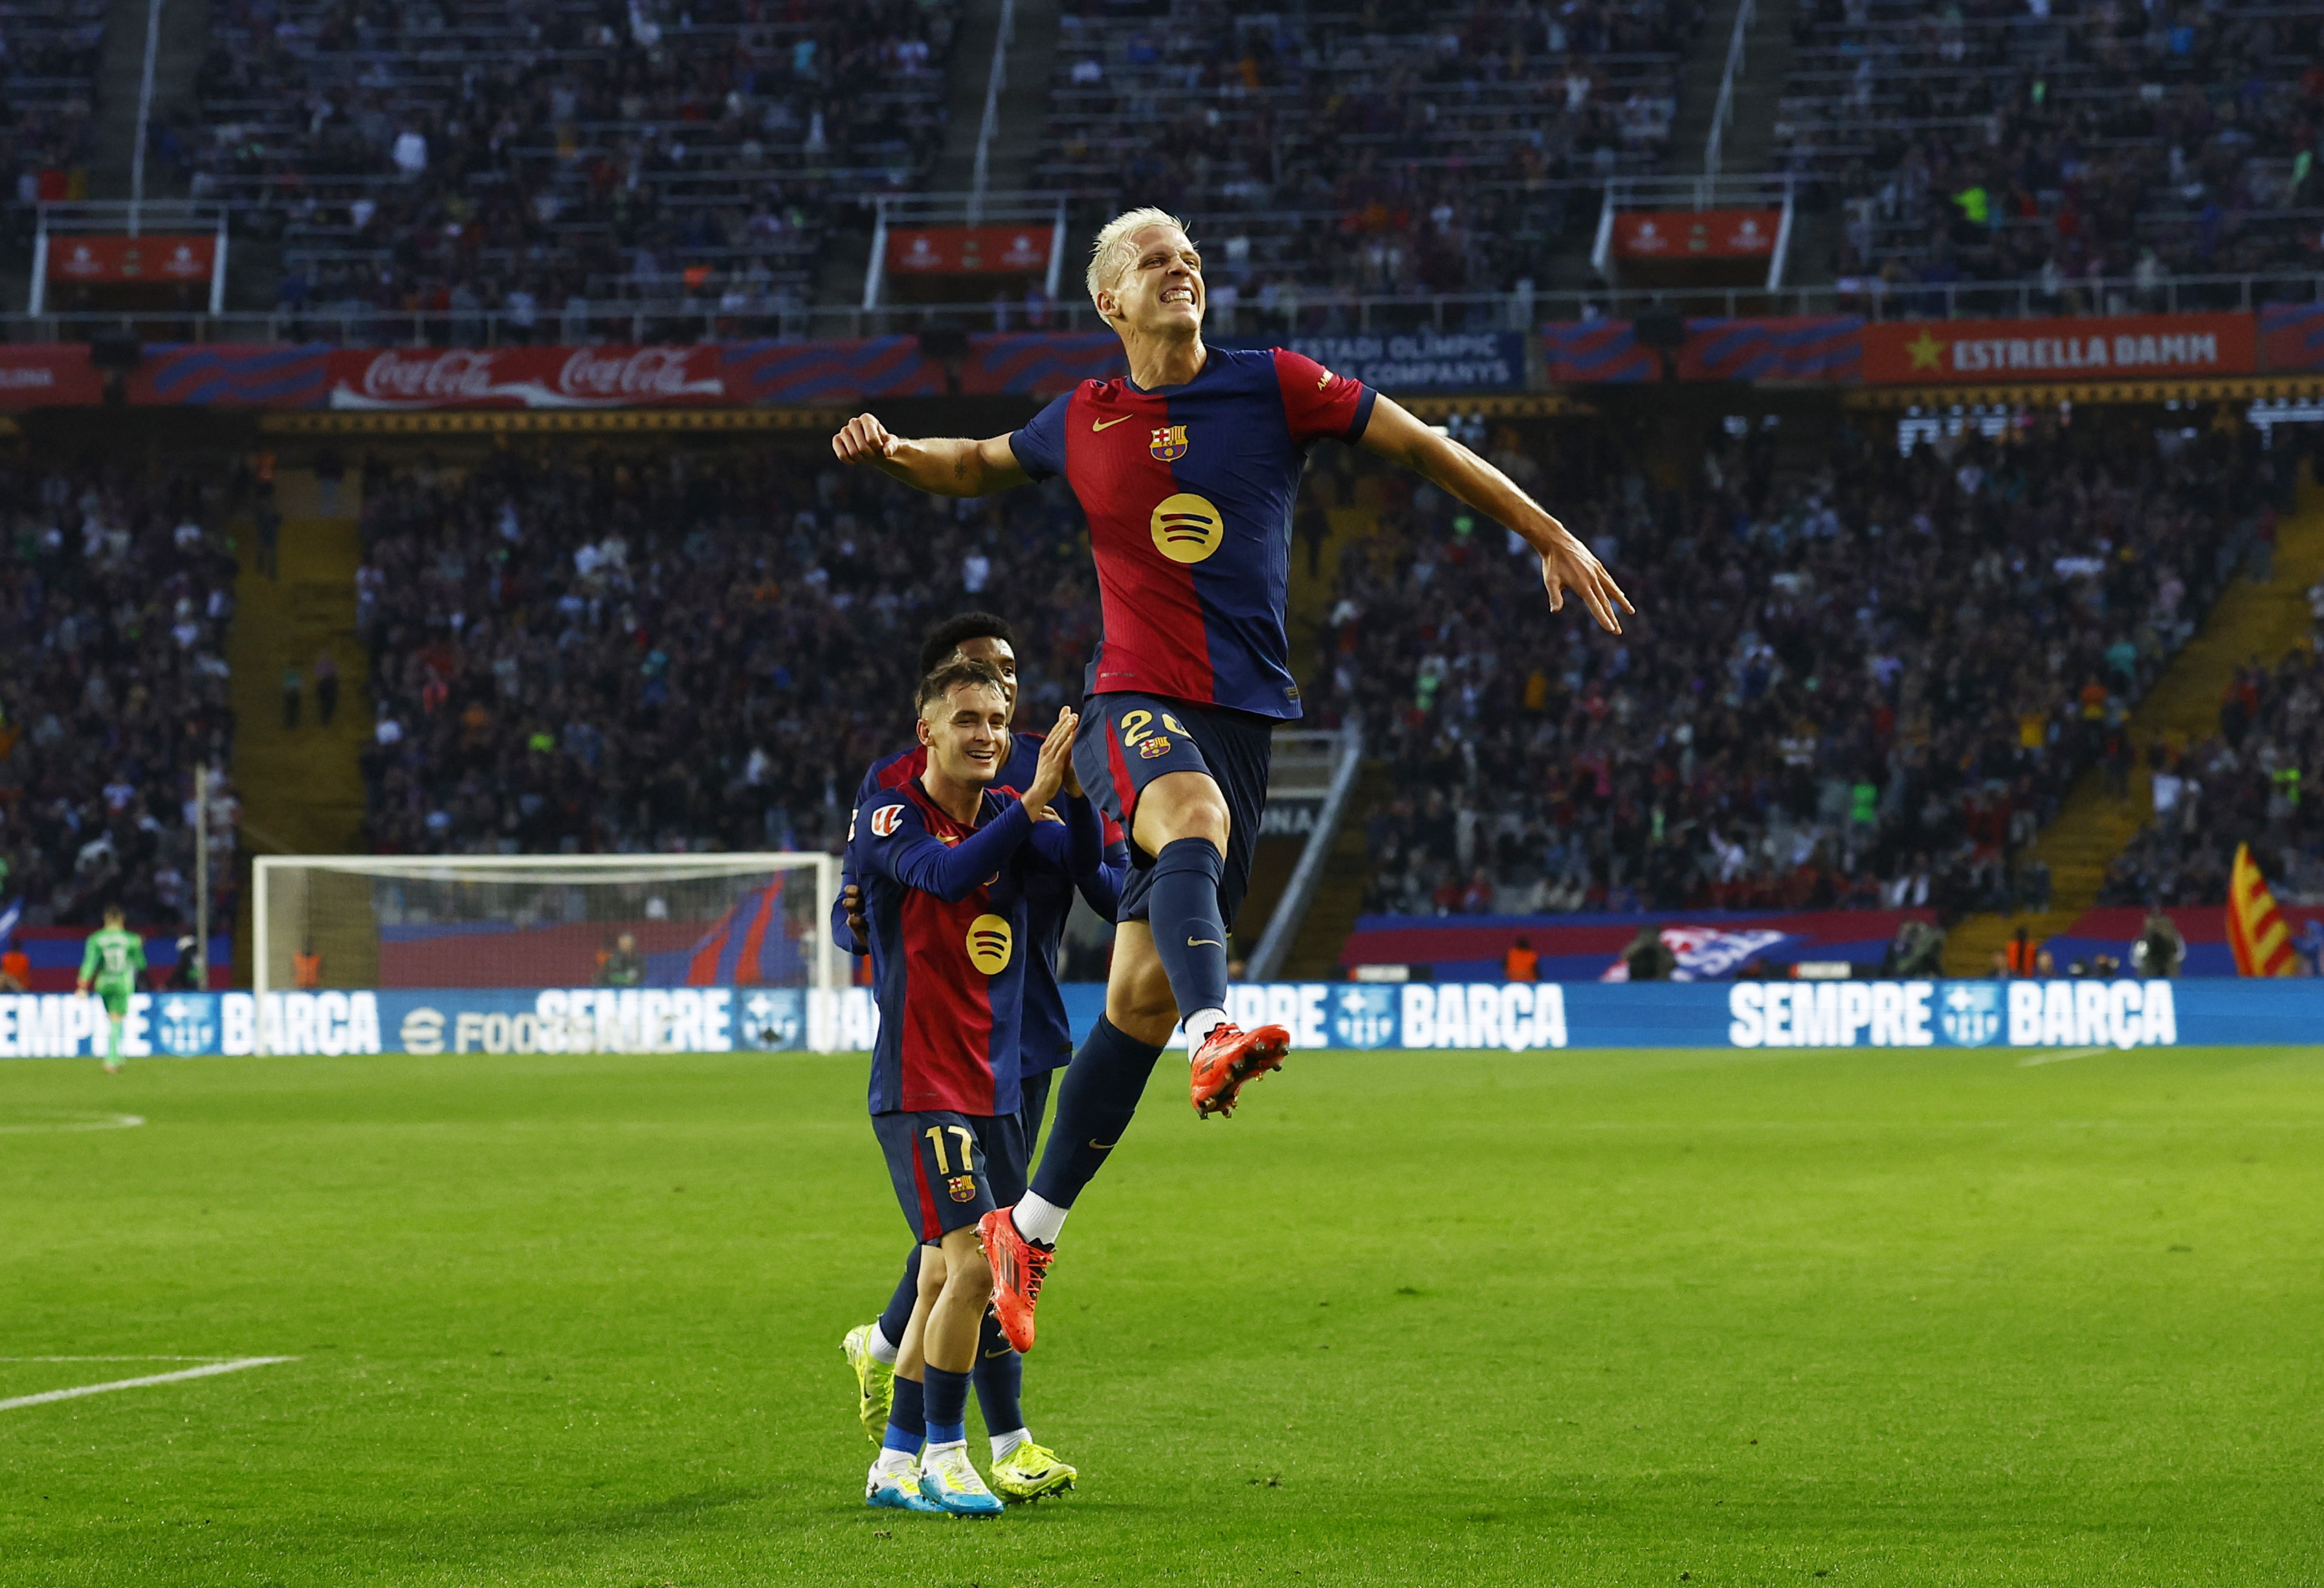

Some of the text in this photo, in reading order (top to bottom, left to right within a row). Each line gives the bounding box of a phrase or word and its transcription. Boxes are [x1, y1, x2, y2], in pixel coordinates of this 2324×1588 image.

[1952, 334, 2218, 371] ESTRELLA DAMM
[536, 989, 732, 1053] SEMPRE
[1400, 983, 1567, 1052] BARÇA
[1729, 980, 2176, 1050] SEMPRE BARÇA
[925, 1125, 973, 1174] 17
